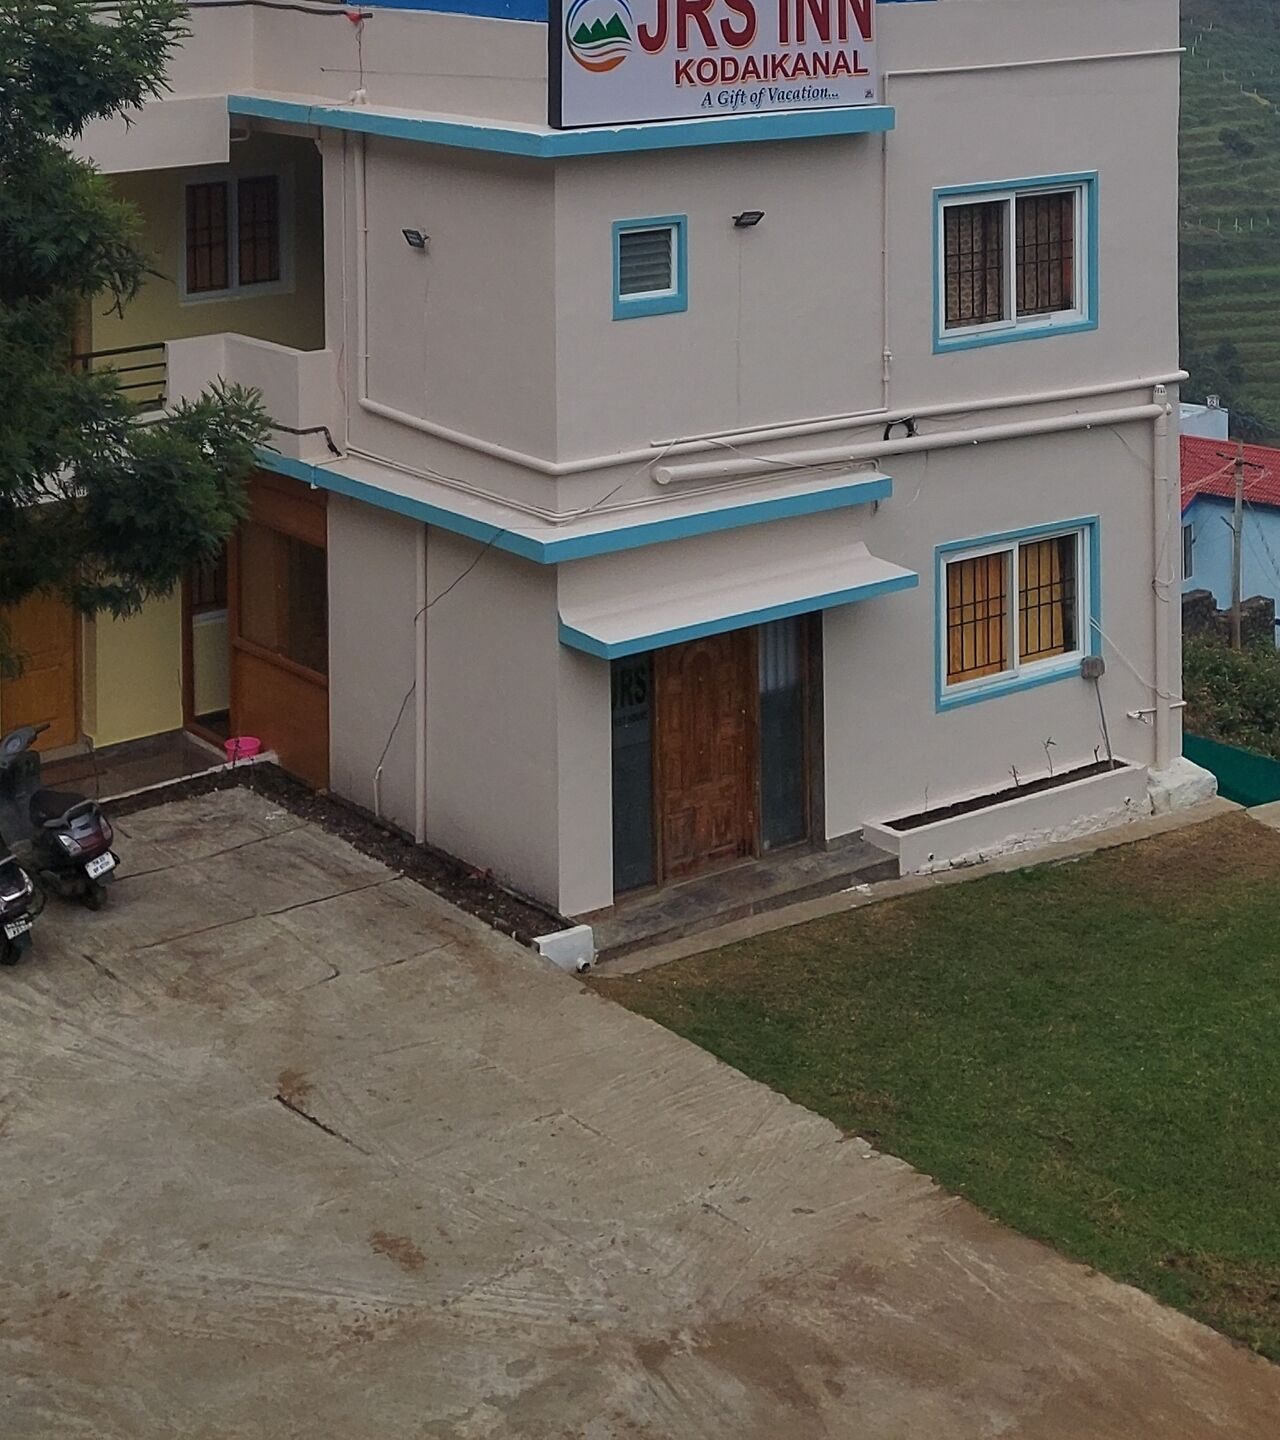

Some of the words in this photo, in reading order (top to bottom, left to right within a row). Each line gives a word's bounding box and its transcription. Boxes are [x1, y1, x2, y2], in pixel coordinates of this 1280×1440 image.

[674, 49, 870, 87] KODAIKANAL
[701, 91, 713, 107] A
[717, 89, 746, 110] Gift
[749, 88, 766, 106] of
[768, 85, 839, 103] Vacation...
